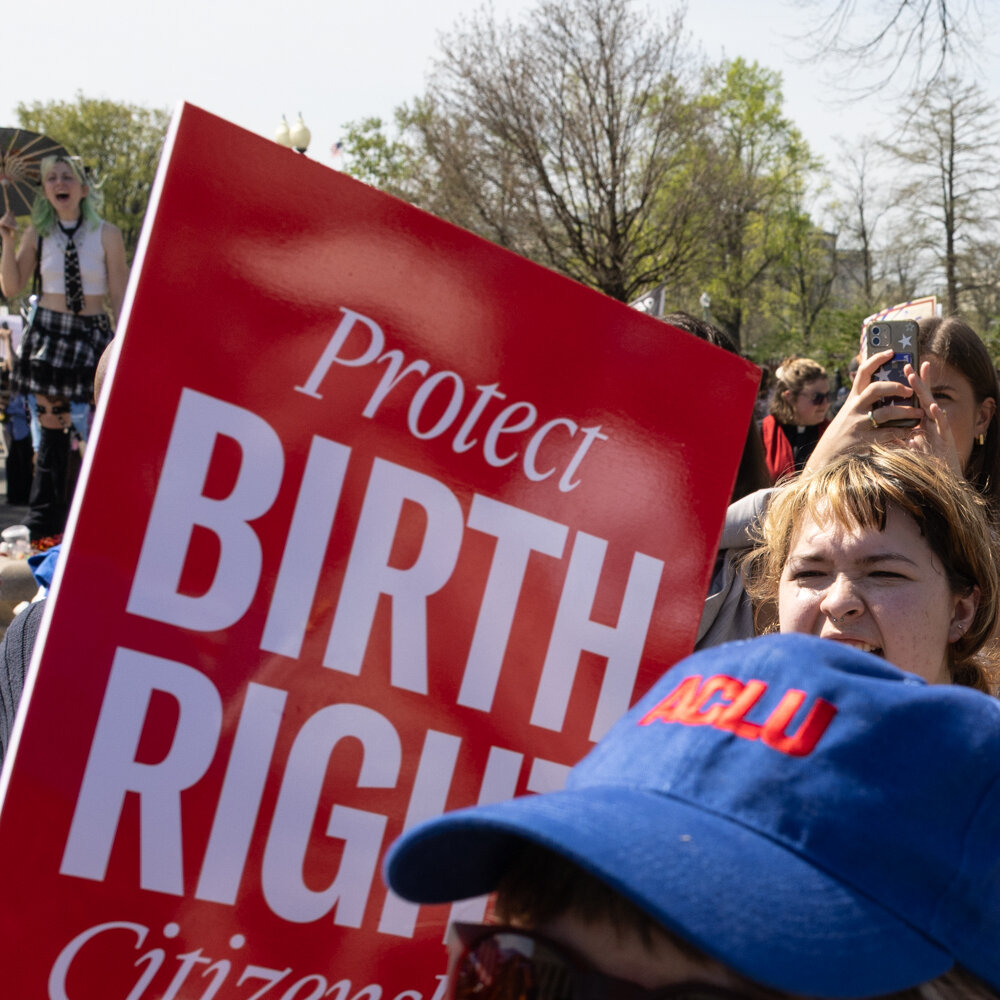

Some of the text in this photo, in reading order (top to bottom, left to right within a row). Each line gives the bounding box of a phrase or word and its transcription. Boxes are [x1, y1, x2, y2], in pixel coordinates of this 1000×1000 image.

[295, 307, 608, 493] Protect
[125, 386, 665, 743] BIRTH
[60, 647, 575, 945] RIGH
[636, 674, 838, 758] ACLU
